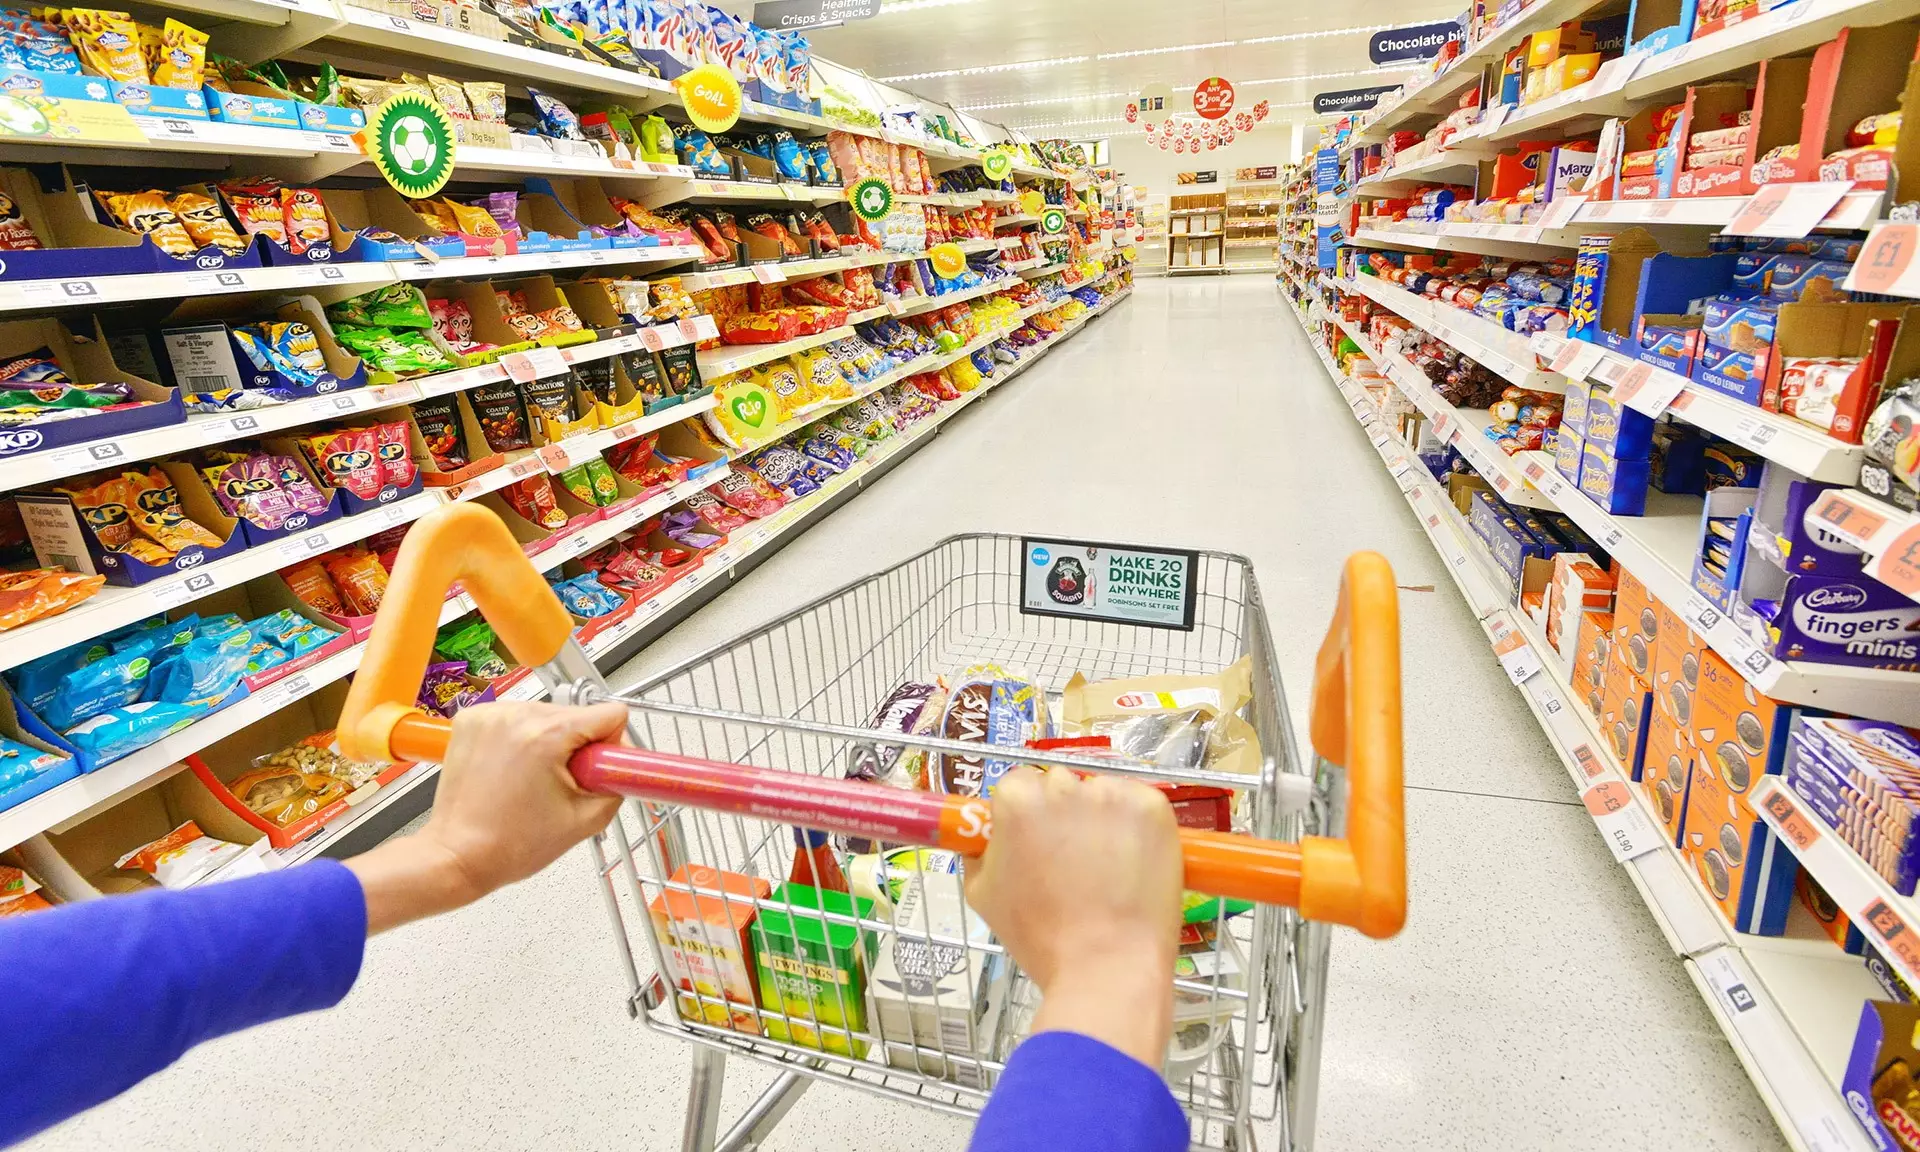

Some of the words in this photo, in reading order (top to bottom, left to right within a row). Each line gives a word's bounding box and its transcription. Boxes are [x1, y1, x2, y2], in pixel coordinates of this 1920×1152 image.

[781, 14, 816, 26] Crisps
[819, 11, 828, 21] &
[831, 7, 872, 20] Snacks
[1378, 32, 1445, 53] Chocolate
[51, 58, 76, 70] Salt
[693, 84, 728, 108] GOAL
[1206, 85, 1222, 93] ANY
[1195, 91, 1208, 109] 3
[1219, 89, 1233, 108] 2
[1319, 95, 1362, 107] Chocolate
[1318, 202, 1339, 210] Brand
[310, 249, 330, 259] KP
[938, 252, 959, 268] GOAL
[1871, 240, 1902, 267] £1
[202, 257, 222, 268] KP
[289, 323, 312, 337] KP
[1640, 352, 1656, 366] CHOCO
[1, 357, 35, 380] SHARE
[256, 375, 269, 385] KP
[319, 381, 336, 393] KP
[526, 379, 565, 393] SENSATIONS
[1702, 373, 1721, 387] CHOCO
[1722, 379, 1745, 395] LEIBNIZ
[474, 389, 517, 403] SENSATIONS
[413, 405, 451, 419] ENSATIONS
[485, 406, 510, 415] COATED
[737, 399, 762, 421] Rio
[0, 431, 37, 451] KP
[333, 450, 372, 470] KP
[542, 455, 551, 466] 2
[554, 449, 568, 462] £2
[233, 477, 272, 496] KP
[381, 490, 397, 503] KP
[85, 505, 126, 526] KP
[287, 515, 306, 529] KP
[179, 553, 202, 568] KP
[1032, 553, 1049, 562] NEW
[1109, 555, 1156, 571] MAKE
[1159, 560, 1183, 573] 20
[1108, 567, 1182, 589] DRINKS
[1108, 585, 1181, 601] ANYWHERE
[1805, 588, 1863, 608] Cadbury
[1107, 597, 1148, 609] ROBINSONS
[1148, 602, 1162, 610] SET
[1162, 604, 1181, 612] FREE
[1807, 614, 1900, 639] fingers
[1846, 638, 1918, 660] minis
[1702, 662, 1717, 683] 36
[988, 705, 1013, 778] Gnary
[1596, 783, 1609, 794] 2
[1604, 796, 1621, 813] £3
[1612, 829, 1634, 852] £1.90
